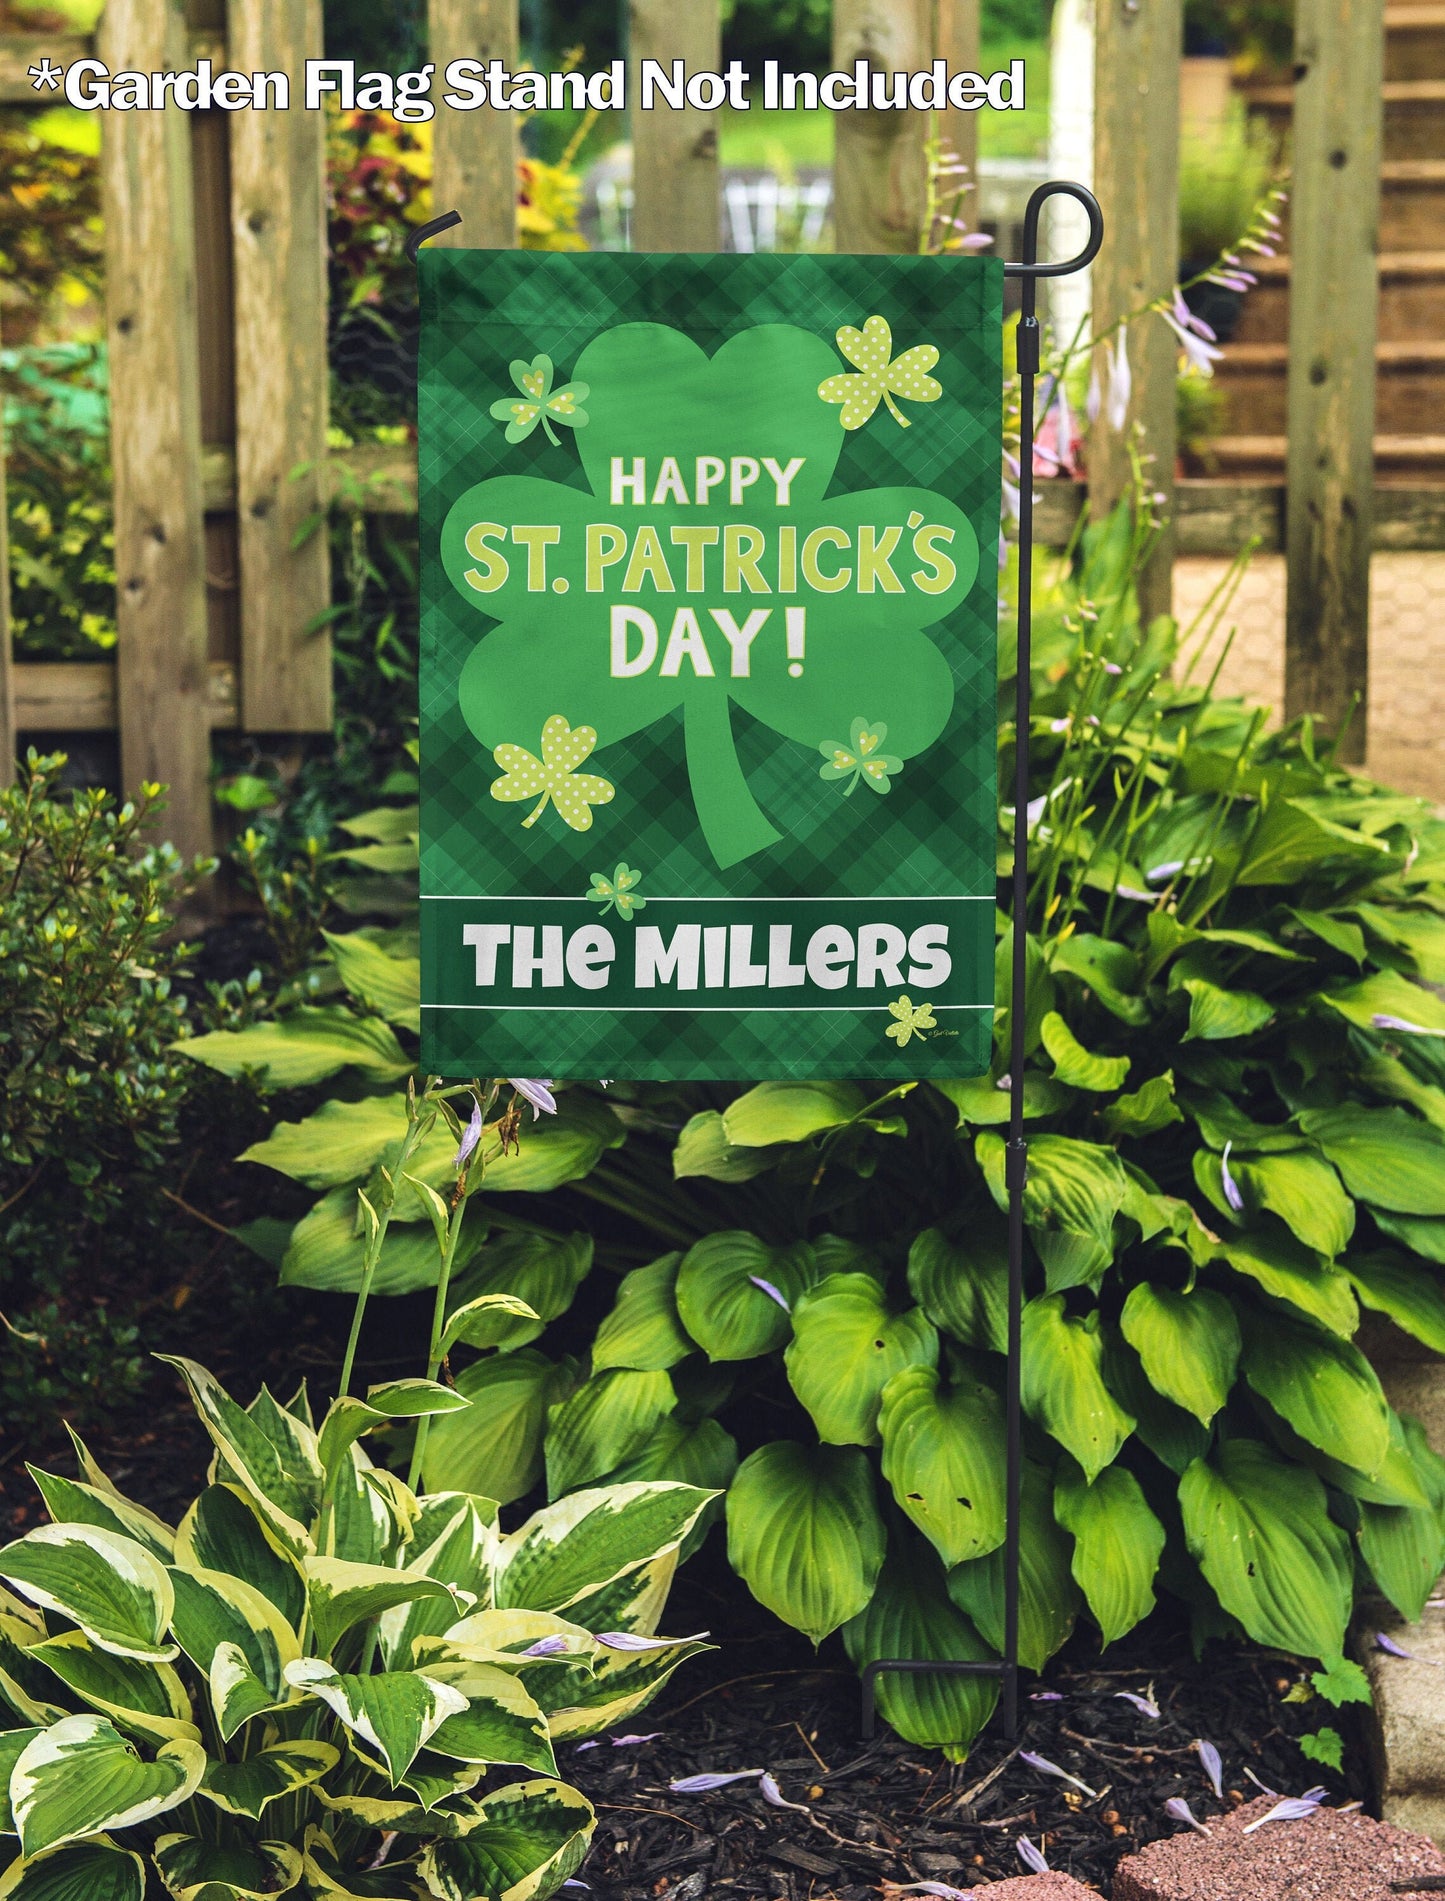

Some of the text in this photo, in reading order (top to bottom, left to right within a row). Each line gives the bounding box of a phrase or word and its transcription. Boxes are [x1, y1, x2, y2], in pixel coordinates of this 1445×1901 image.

[609, 456, 806, 506] HAPPY
[463, 510, 957, 595] ST. PATRICK'S
